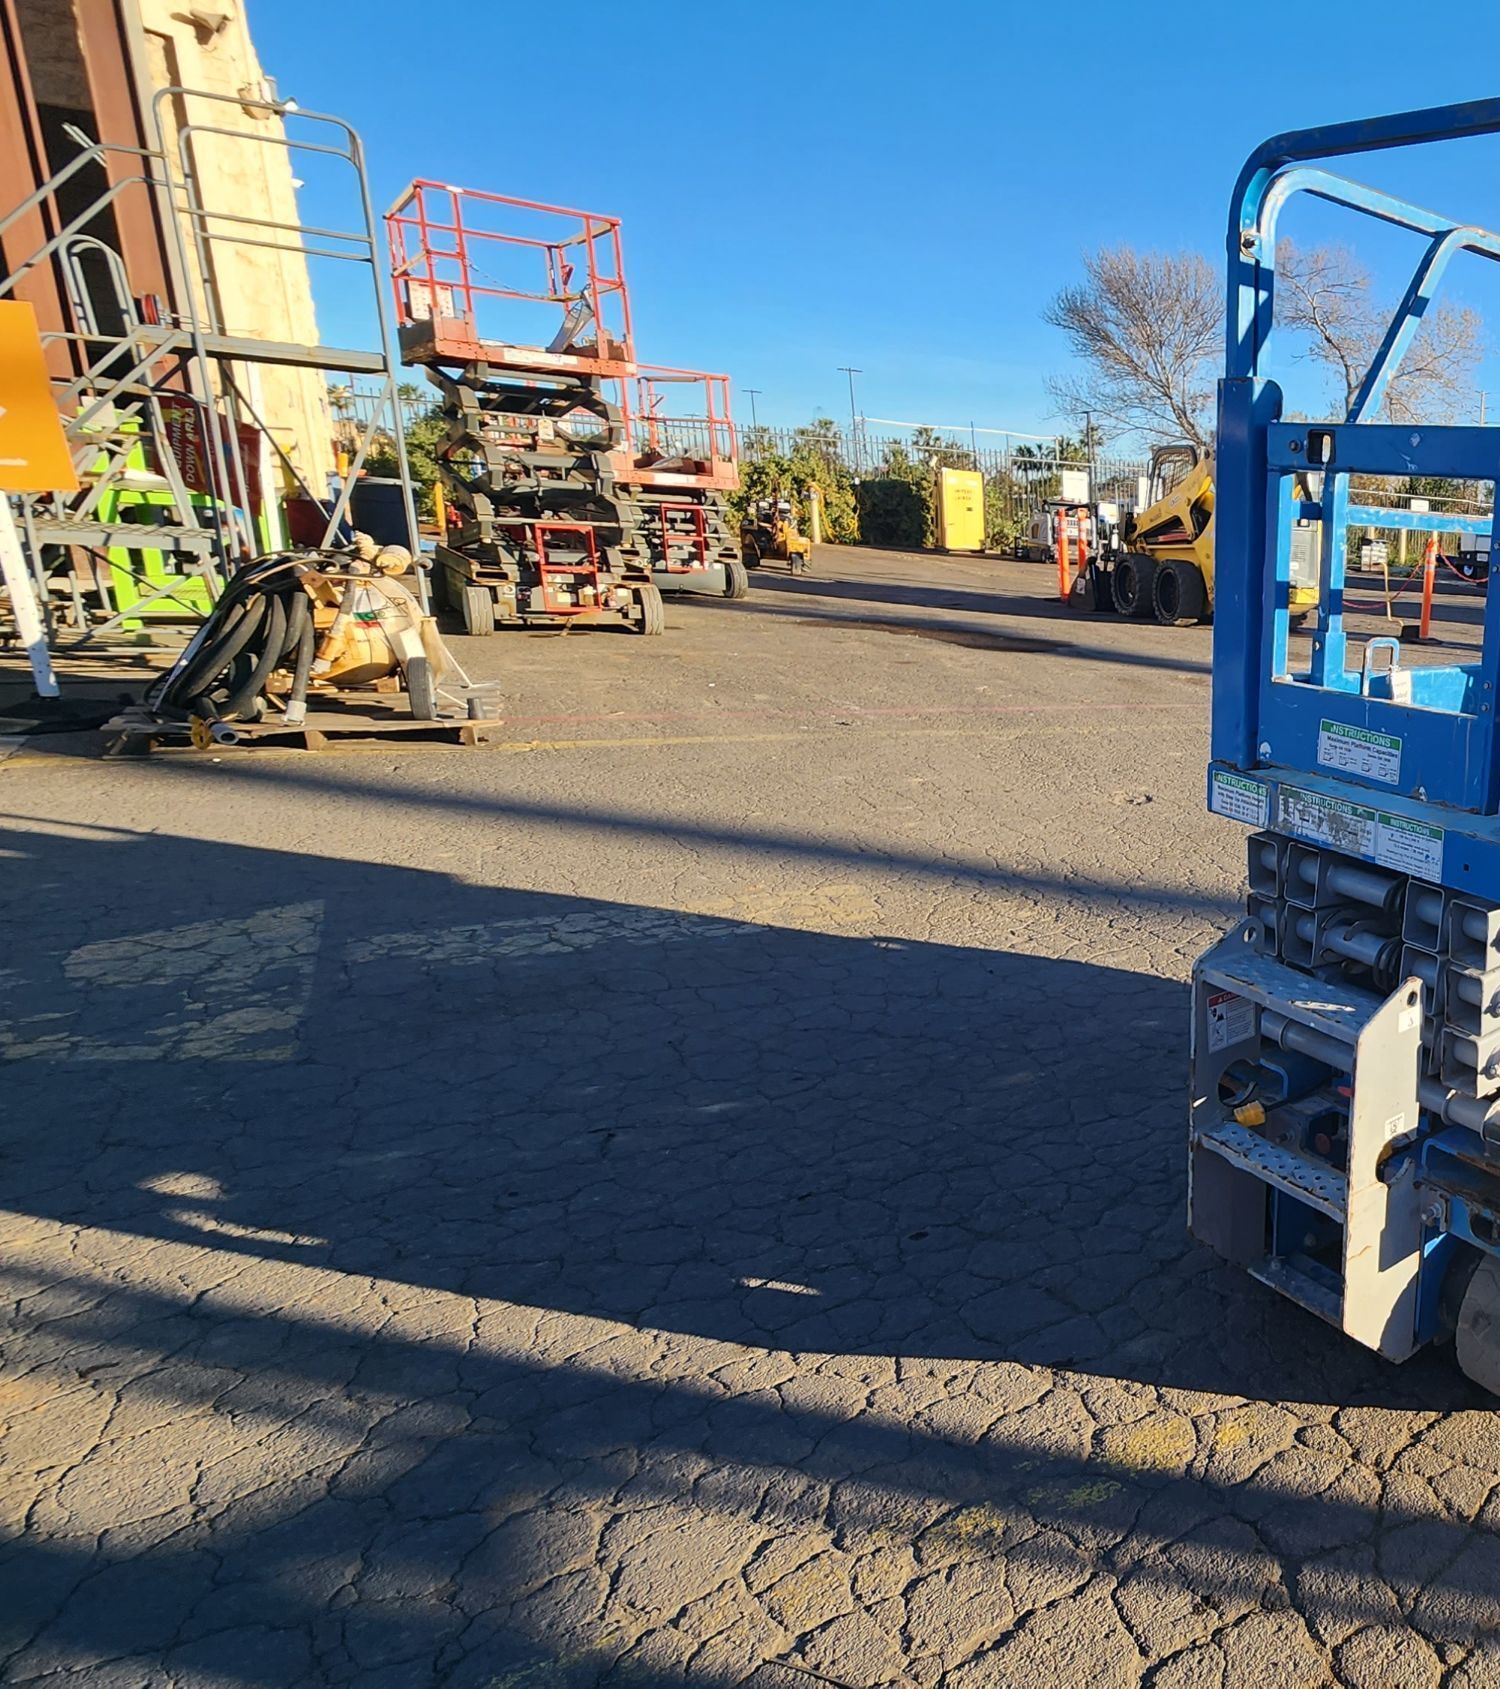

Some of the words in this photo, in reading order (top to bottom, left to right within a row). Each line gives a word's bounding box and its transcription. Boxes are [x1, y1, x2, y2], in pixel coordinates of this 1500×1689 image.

[171, 402, 182, 468] QUIPMENT
[185, 444, 195, 483] DOWN
[1330, 724, 1391, 747] INSTRUCTIONS
